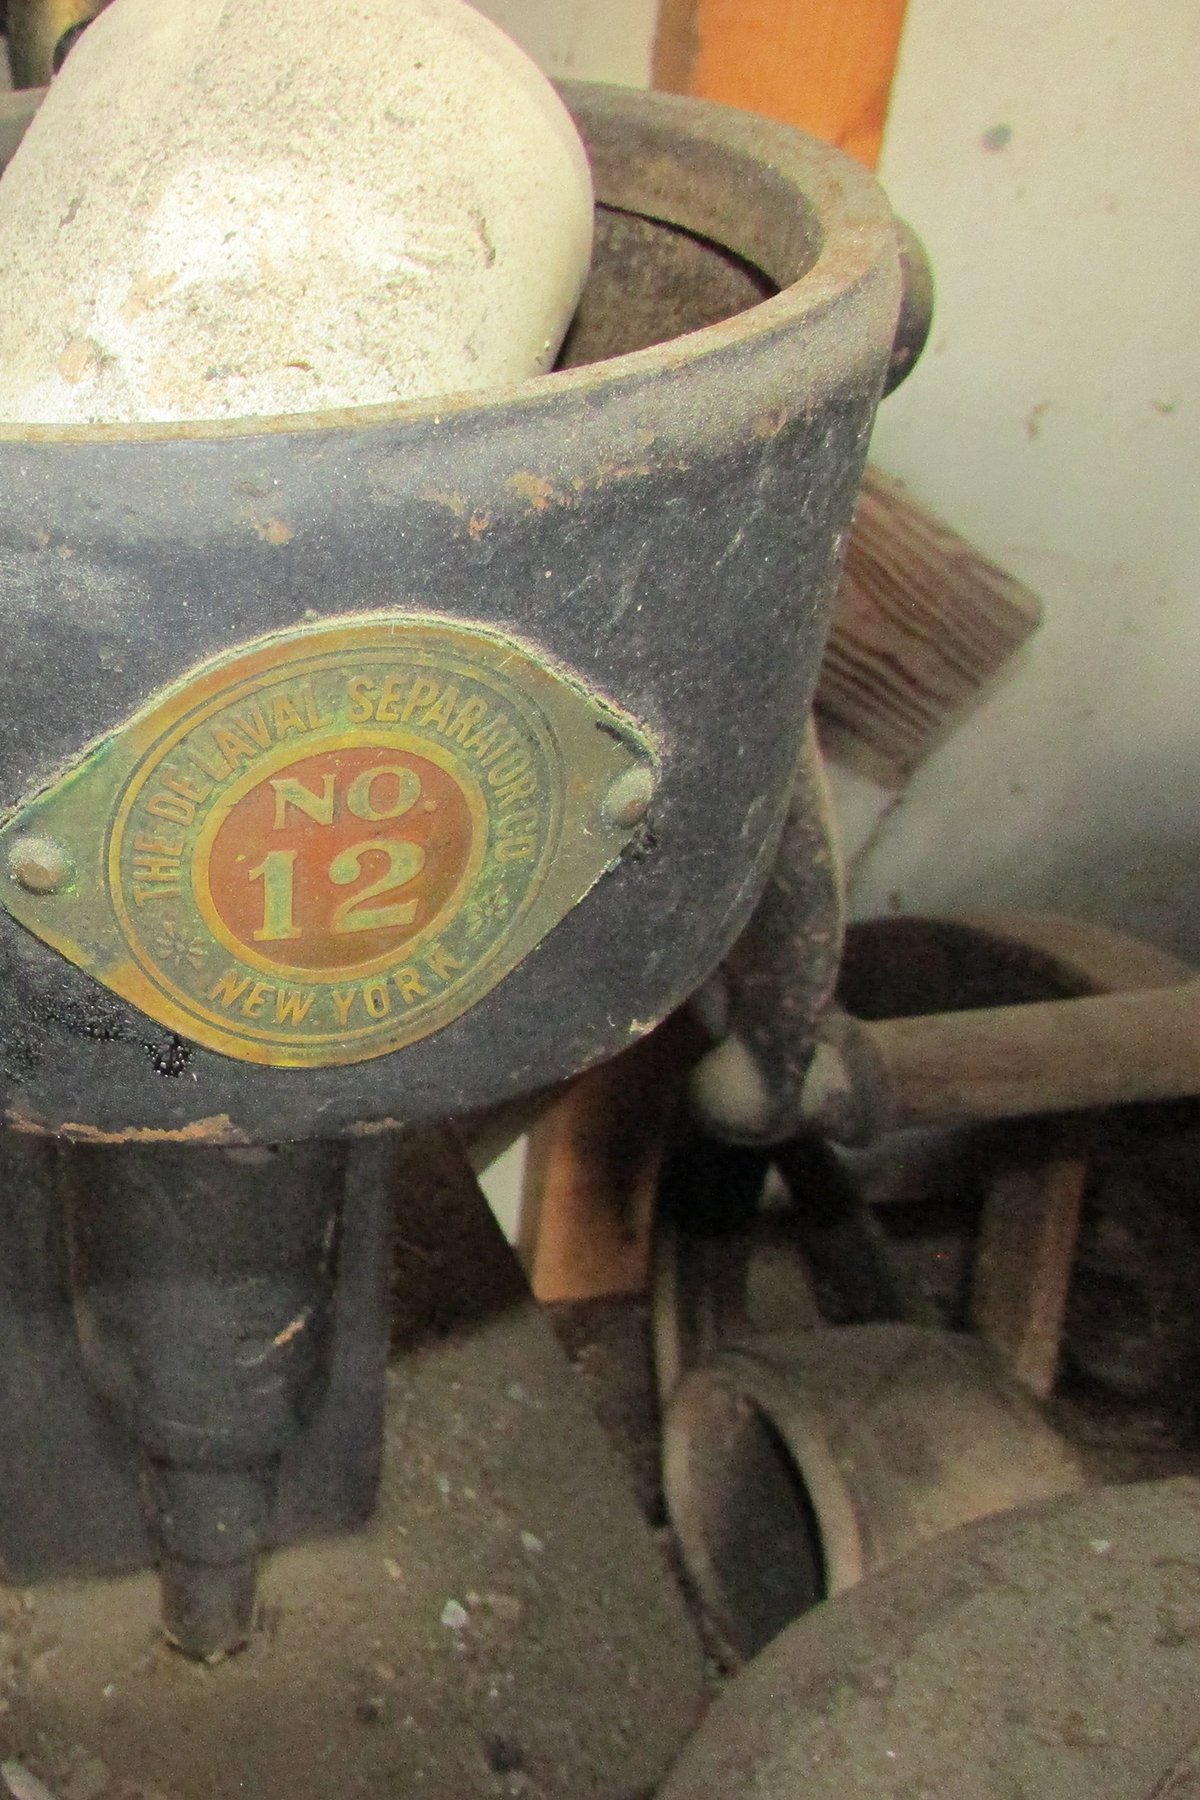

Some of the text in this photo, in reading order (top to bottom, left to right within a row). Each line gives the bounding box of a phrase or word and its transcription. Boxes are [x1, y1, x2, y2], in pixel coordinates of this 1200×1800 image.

[188, 684, 334, 782] LAVAL
[347, 673, 537, 808] SEPARATOR
[144, 766, 214, 827] DE
[269, 764, 438, 830] NO.
[132, 830, 184, 908] THE
[248, 838, 426, 942] 12
[206, 941, 467, 1027] NEW YORK
